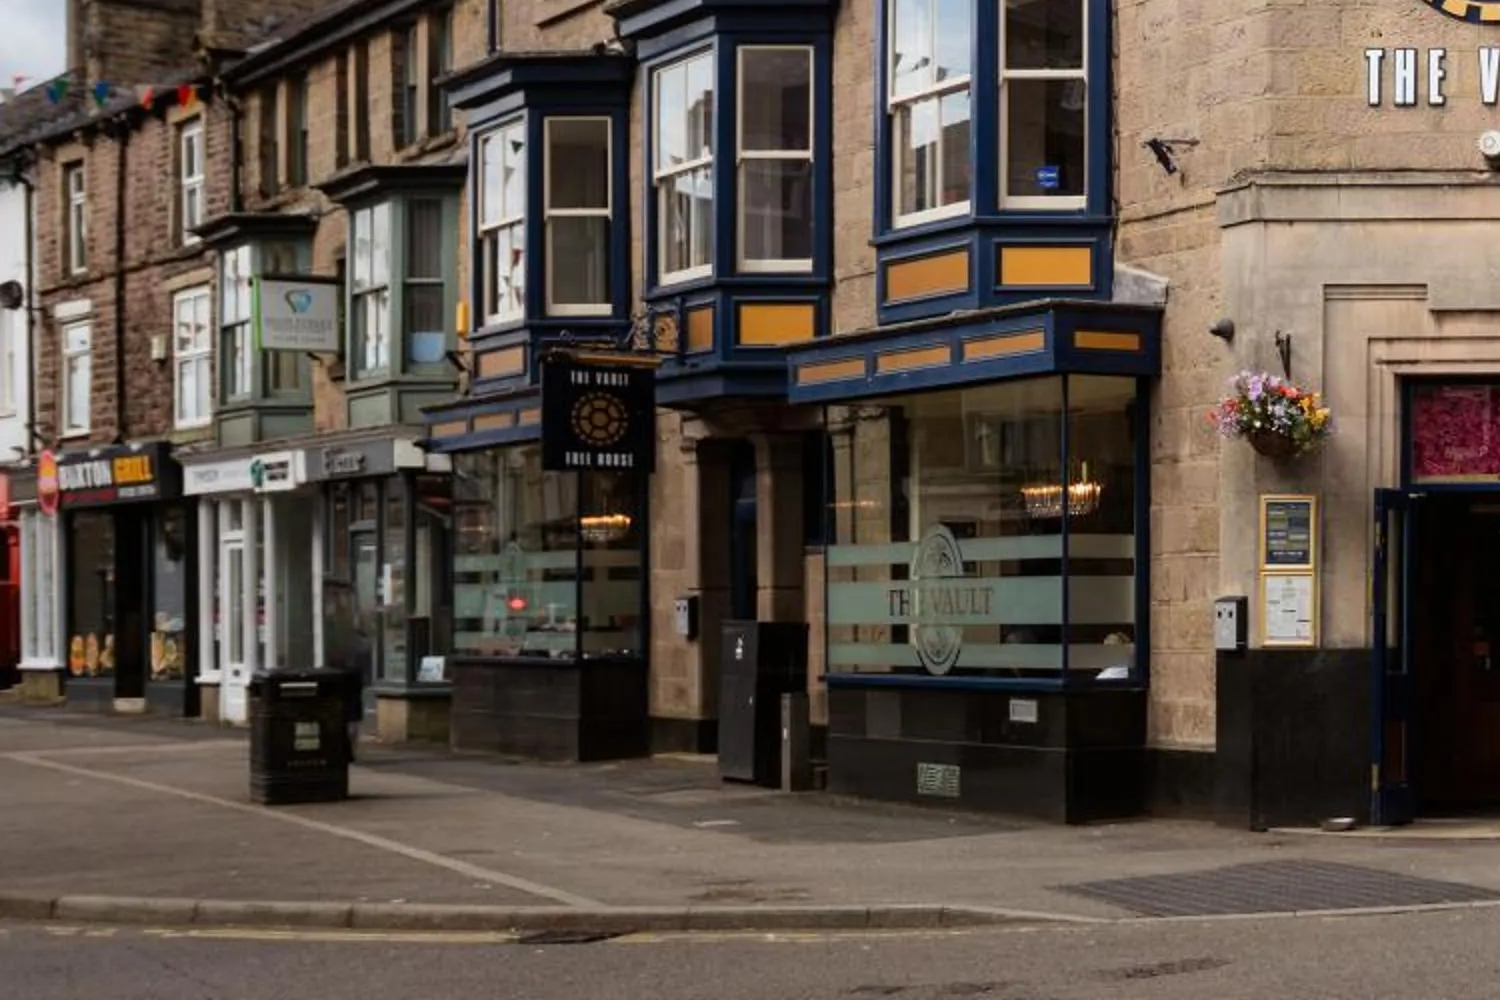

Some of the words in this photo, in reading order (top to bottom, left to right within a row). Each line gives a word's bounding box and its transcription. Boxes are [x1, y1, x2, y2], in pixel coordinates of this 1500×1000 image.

[1365, 48, 1446, 106] THE
[571, 370, 589, 385] THE
[596, 372, 629, 387] VAULT
[598, 452, 633, 468] HOUSE
